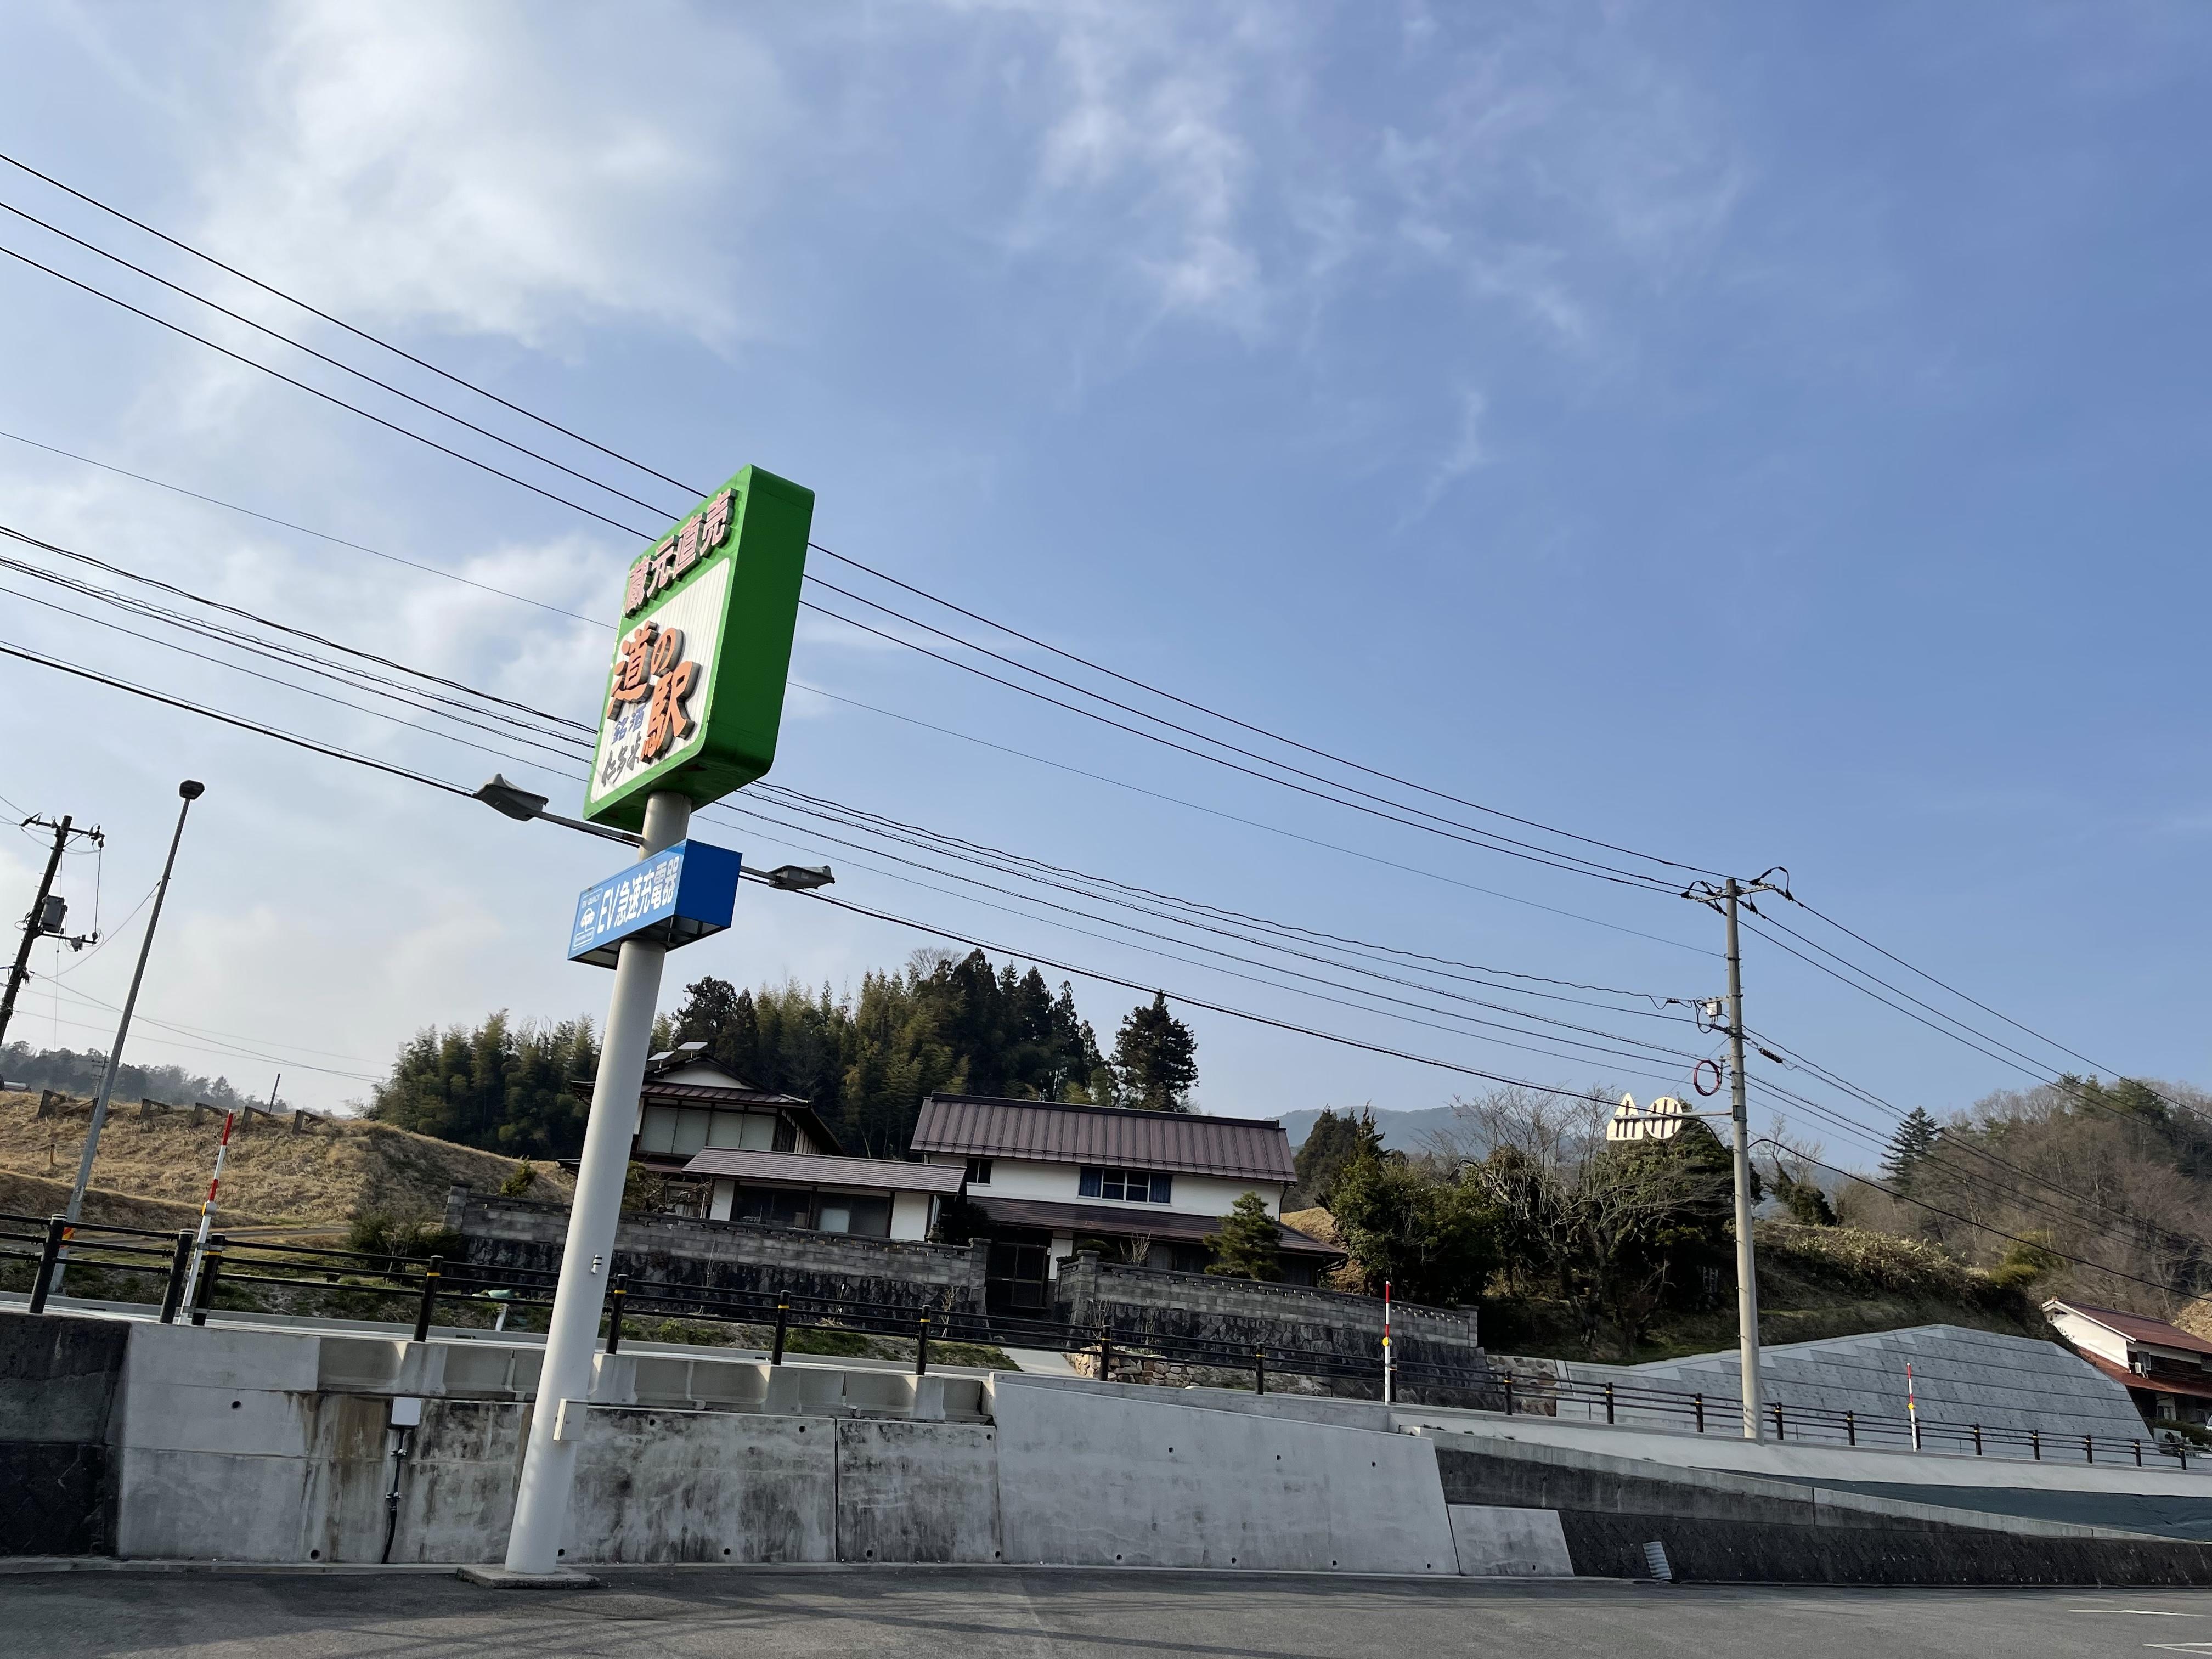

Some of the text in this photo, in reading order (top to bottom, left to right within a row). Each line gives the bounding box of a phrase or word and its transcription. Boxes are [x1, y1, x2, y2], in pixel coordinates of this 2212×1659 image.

[623, 488, 733, 617] 蔵元直売
[605, 621, 695, 761] 道の駅
[597, 855, 680, 934] EV急速充電器
